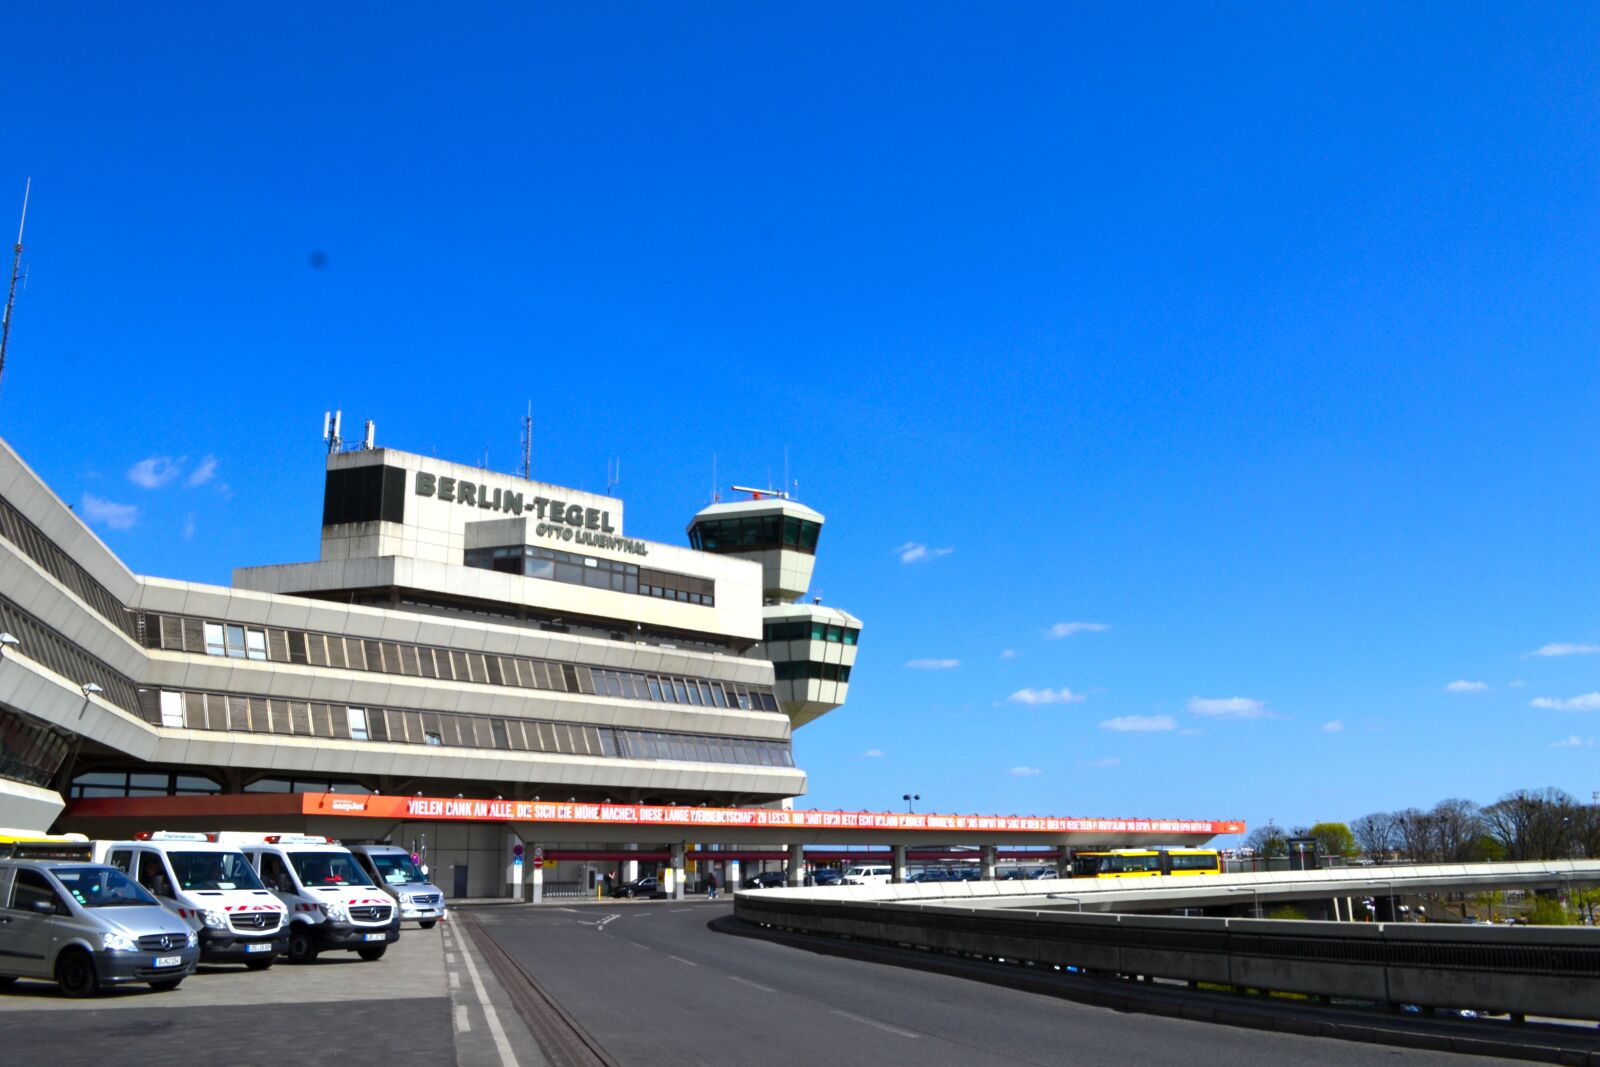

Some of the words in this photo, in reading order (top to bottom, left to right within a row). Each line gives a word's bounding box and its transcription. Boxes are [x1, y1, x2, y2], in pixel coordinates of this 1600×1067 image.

[415, 471, 615, 533] BERLIN-TEGEL
[536, 522, 573, 542] OTTO
[575, 530, 649, 556] LILIENTHAL
[408, 800, 443, 815] VIELEN
[446, 801, 473, 816] DANK
[474, 802, 487, 817] AN
[489, 803, 515, 819] ALLE,
[517, 804, 533, 818] DIE
[534, 804, 555, 819] SICH
[557, 805, 572, 819] DIE
[575, 804, 600, 820] MÜHE
[640, 807, 663, 821] DIESE
[665, 808, 689, 822] LANGE
